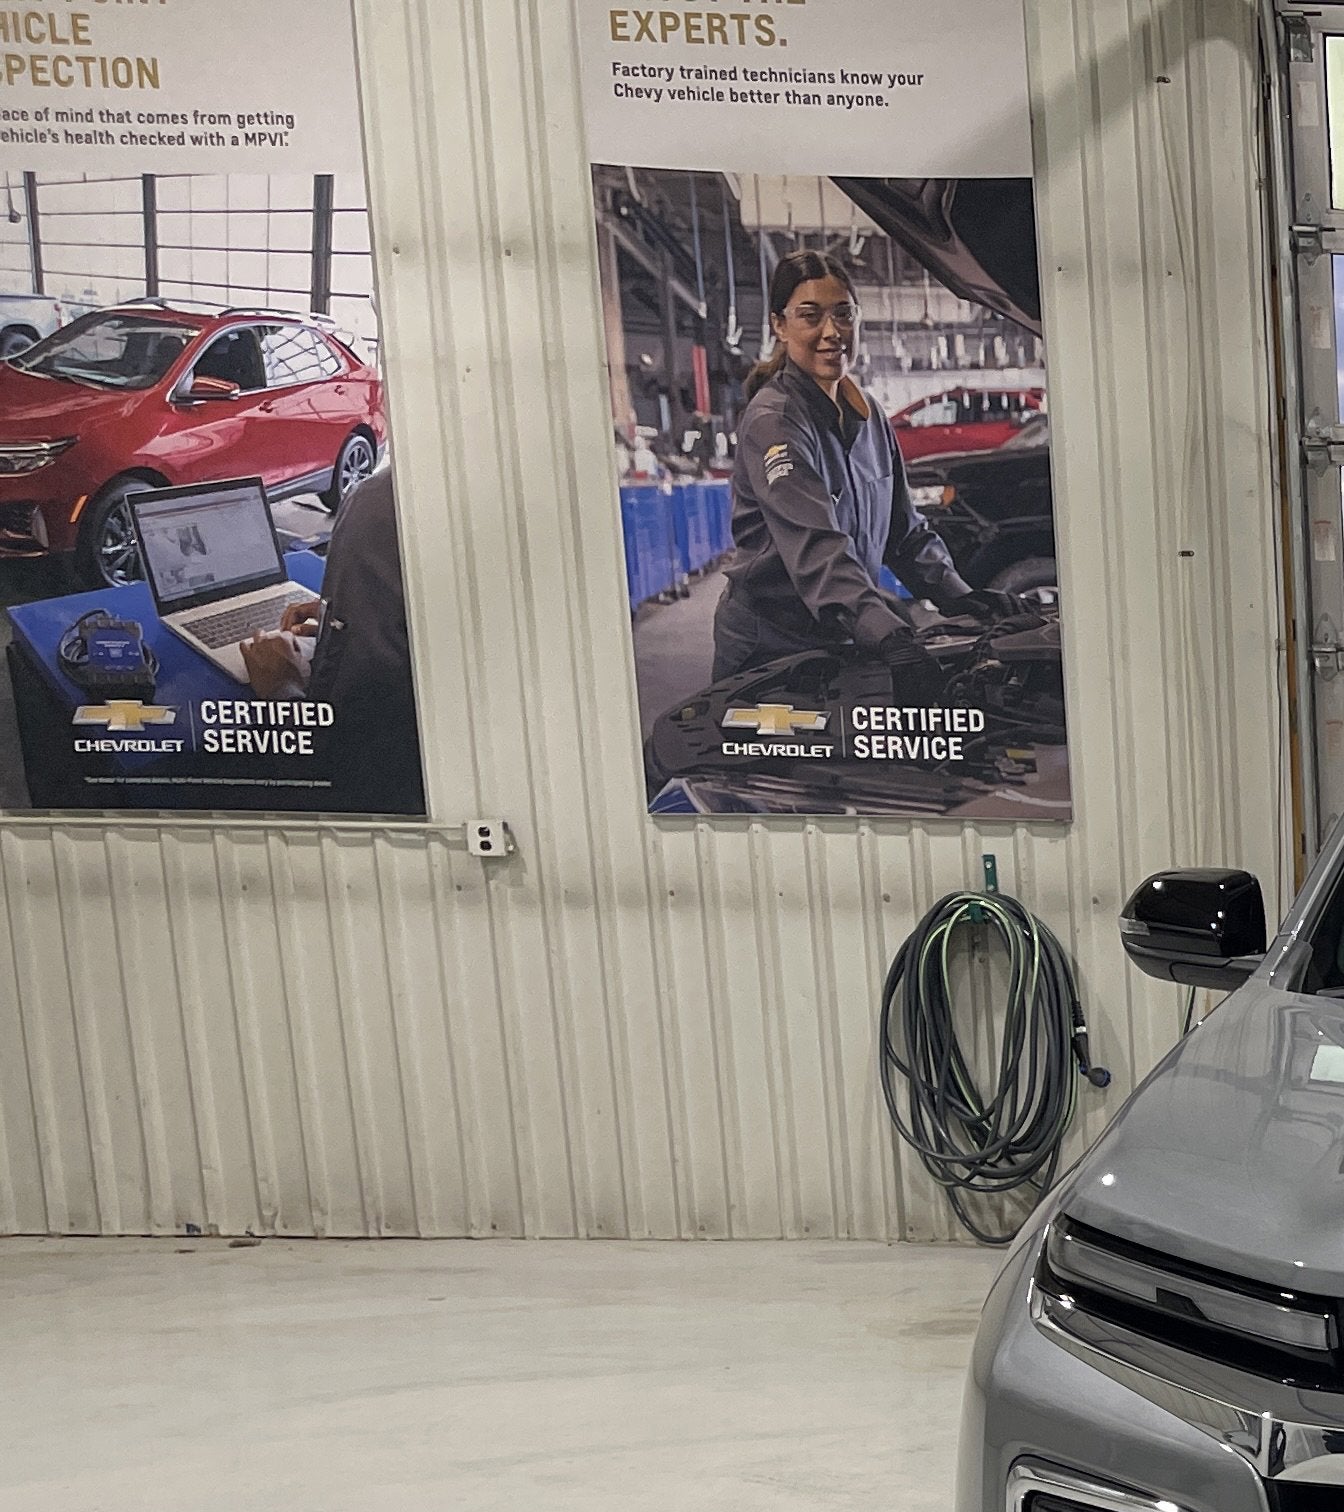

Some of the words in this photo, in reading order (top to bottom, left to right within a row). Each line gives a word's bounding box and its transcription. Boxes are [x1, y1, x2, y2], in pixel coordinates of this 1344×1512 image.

[609, 9, 788, 47] EXPERTS.
[0, 53, 160, 89] PECTION
[612, 61, 675, 83] Factory
[680, 64, 738, 81] trained
[743, 67, 836, 84] technicians
[841, 69, 883, 86] know
[888, 73, 924, 89] your
[614, 83, 663, 103] Chevy
[668, 85, 724, 102] vehicle
[730, 88, 780, 105] better
[785, 89, 821, 106] than
[827, 92, 889, 110] anyone.
[0, 109, 29, 121] ace
[34, 106, 50, 122] of
[55, 107, 94, 123] mind
[98, 109, 132, 124] that
[137, 112, 188, 125] comes
[193, 109, 231, 125] from
[237, 111, 295, 129] getting
[0, 128, 60, 144] ehicle's
[64, 129, 115, 145] health
[120, 131, 186, 146] checked
[189, 132, 226, 147] with
[231, 135, 239, 147] a
[201, 700, 334, 728] CERTIFIED
[852, 706, 985, 732] CERTIFIED
[74, 739, 185, 753] CHEVROLET
[204, 729, 314, 755] SERVICE
[722, 741, 834, 758] CHEVROLET
[853, 735, 964, 760] SERVICE
